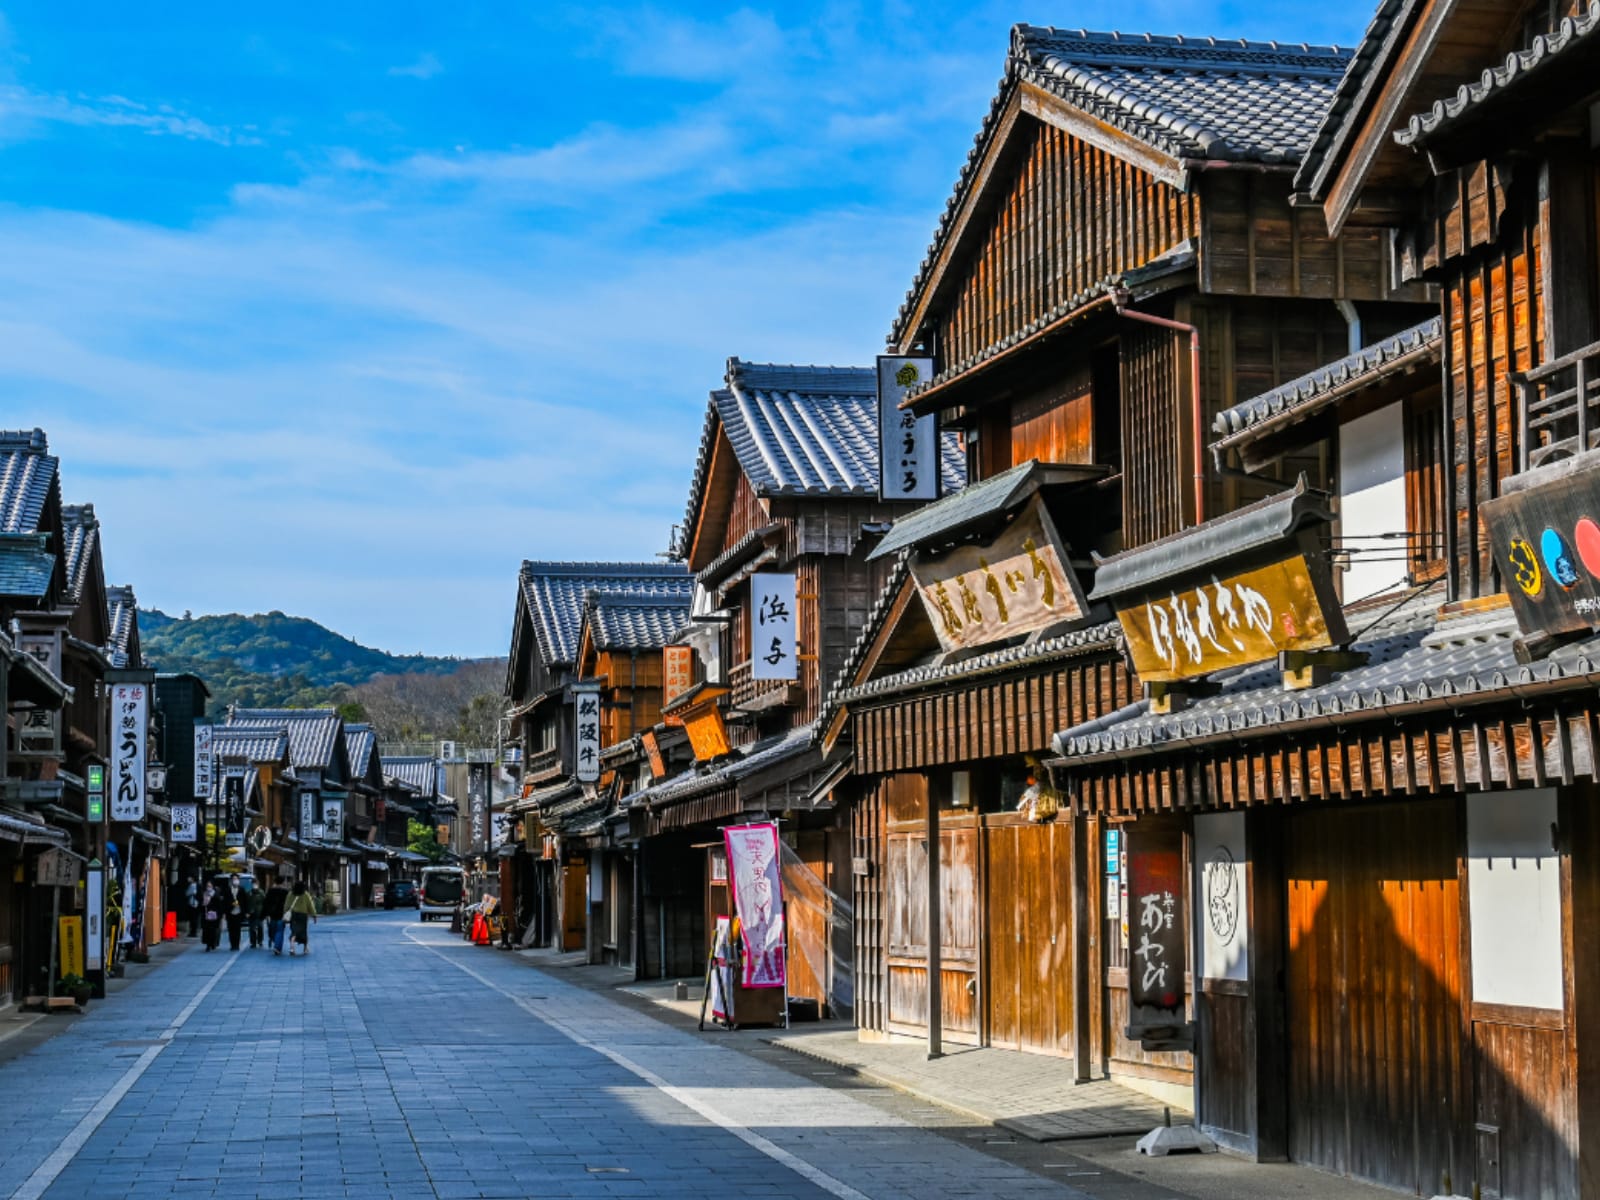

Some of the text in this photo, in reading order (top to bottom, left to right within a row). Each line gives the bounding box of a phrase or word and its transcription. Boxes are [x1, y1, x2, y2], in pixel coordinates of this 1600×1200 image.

[760, 594, 789, 666] 浜与
[1146, 574, 1277, 672] 伊勢せきや
[118, 702, 138, 803] 伊勢うどん
[579, 697, 598, 765] 松阪牛
[1134, 894, 1170, 992] あわび
